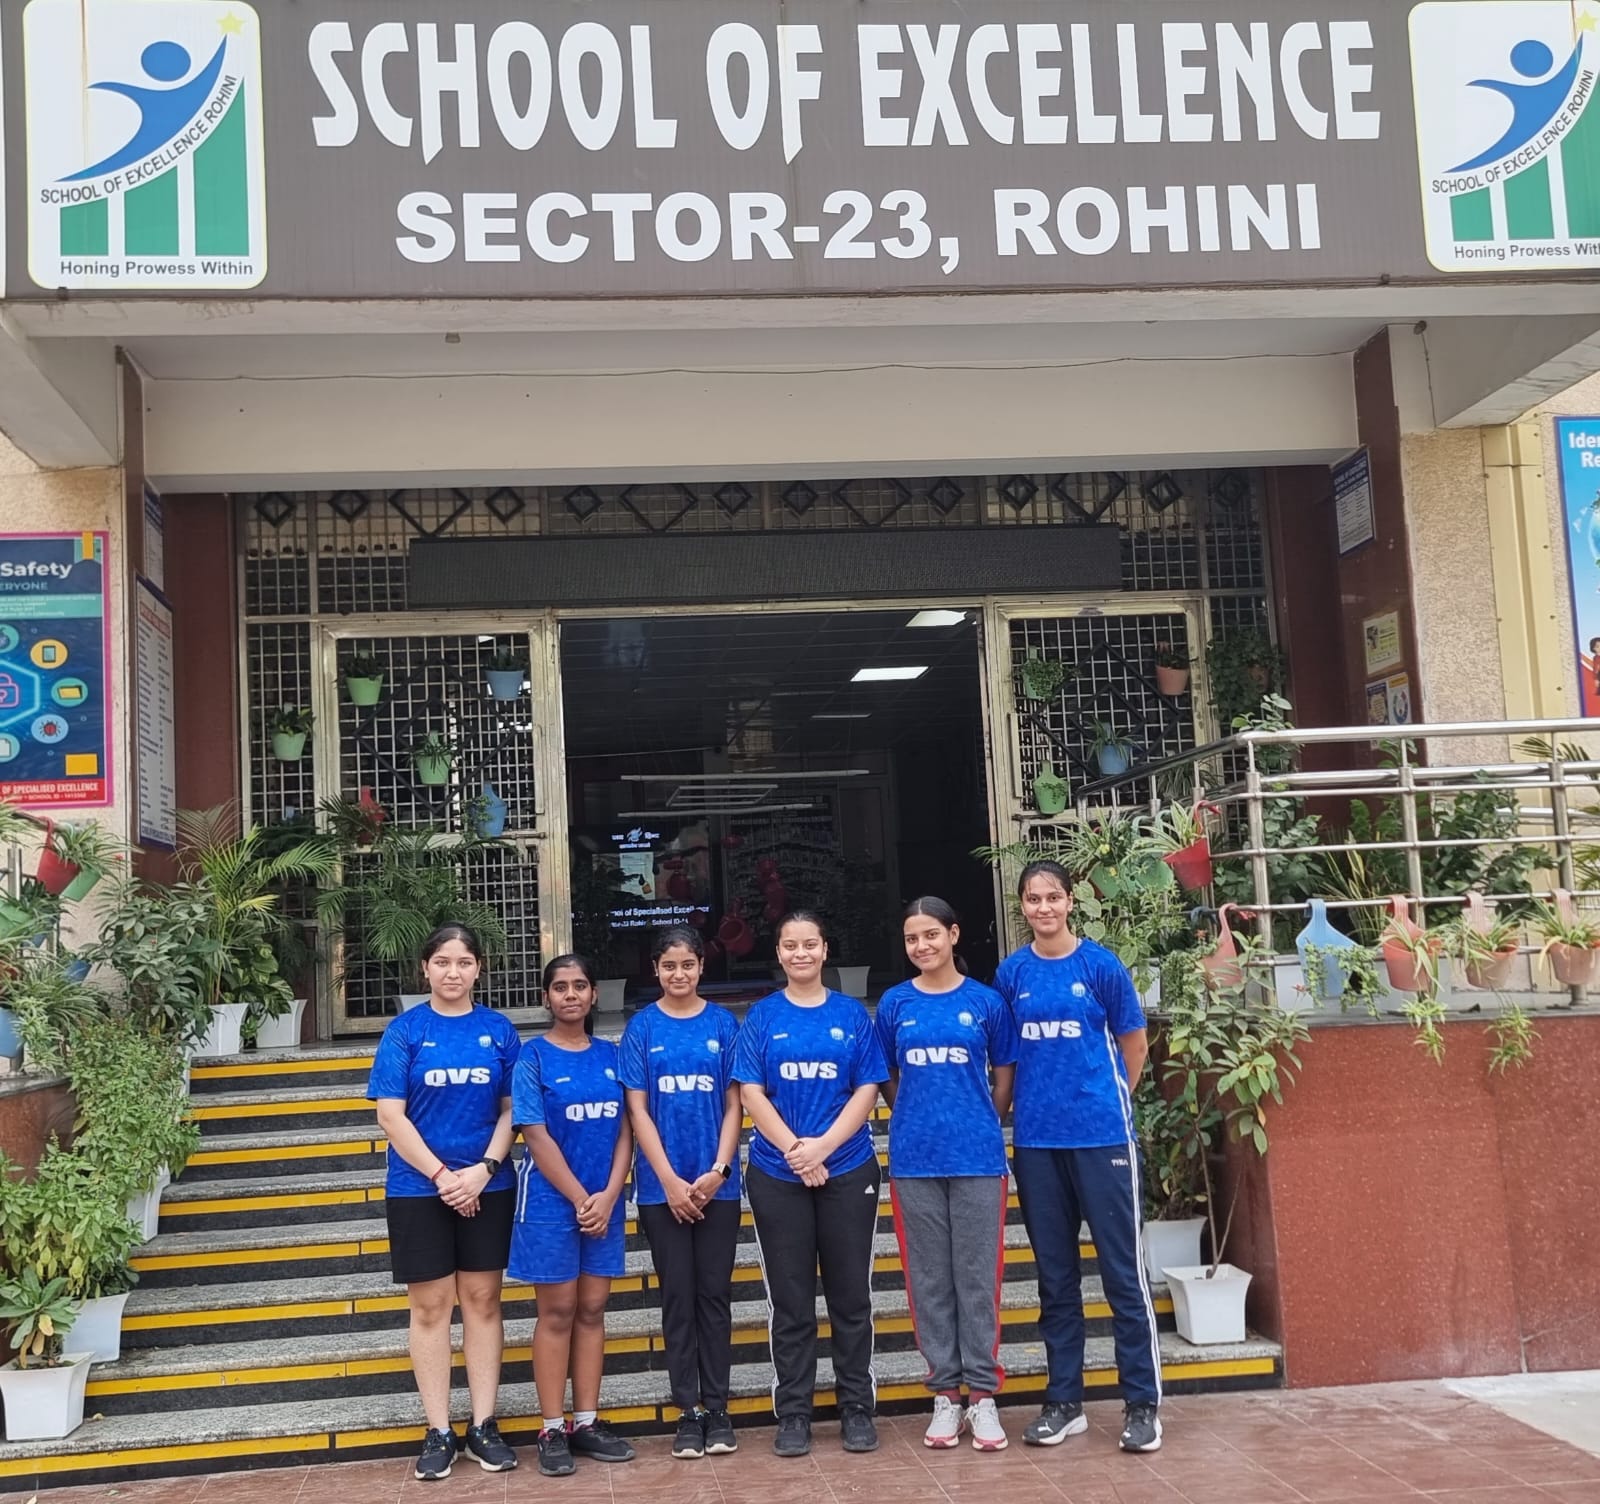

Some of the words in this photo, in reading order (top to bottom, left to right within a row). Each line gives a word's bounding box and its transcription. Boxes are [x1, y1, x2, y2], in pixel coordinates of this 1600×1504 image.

[308, 21, 678, 164] SCHOOL
[706, 22, 823, 164] OF
[857, 20, 1381, 147] EXCELLENCE
[41, 184, 101, 204] SCHOOL
[103, 175, 123, 194] OF
[126, 120, 208, 185] EXCELLENCE
[204, 75, 238, 124] ROHINI
[1432, 174, 1484, 194] SCHOOL
[1485, 166, 1502, 184] OF
[1503, 111, 1572, 175] EXCELLENCE
[1569, 69, 1594, 118] ROHINI
[396, 189, 960, 275] SECTOR-23,
[993, 183, 1321, 256] ROHINI
[1454, 246, 1506, 261] Honing
[1510, 244, 1571, 257] Prowess
[60, 261, 120, 278] Honing
[125, 261, 196, 275] Prowess
[201, 261, 253, 275] Within
[0, 561, 73, 579] Safety
[1021, 1020, 1082, 1041] QVS
[906, 1046, 969, 1065] QVS
[424, 1067, 491, 1087] QVS
[779, 1061, 838, 1081] QVS
[658, 1074, 714, 1093] QVS
[565, 1101, 619, 1122] QVS
